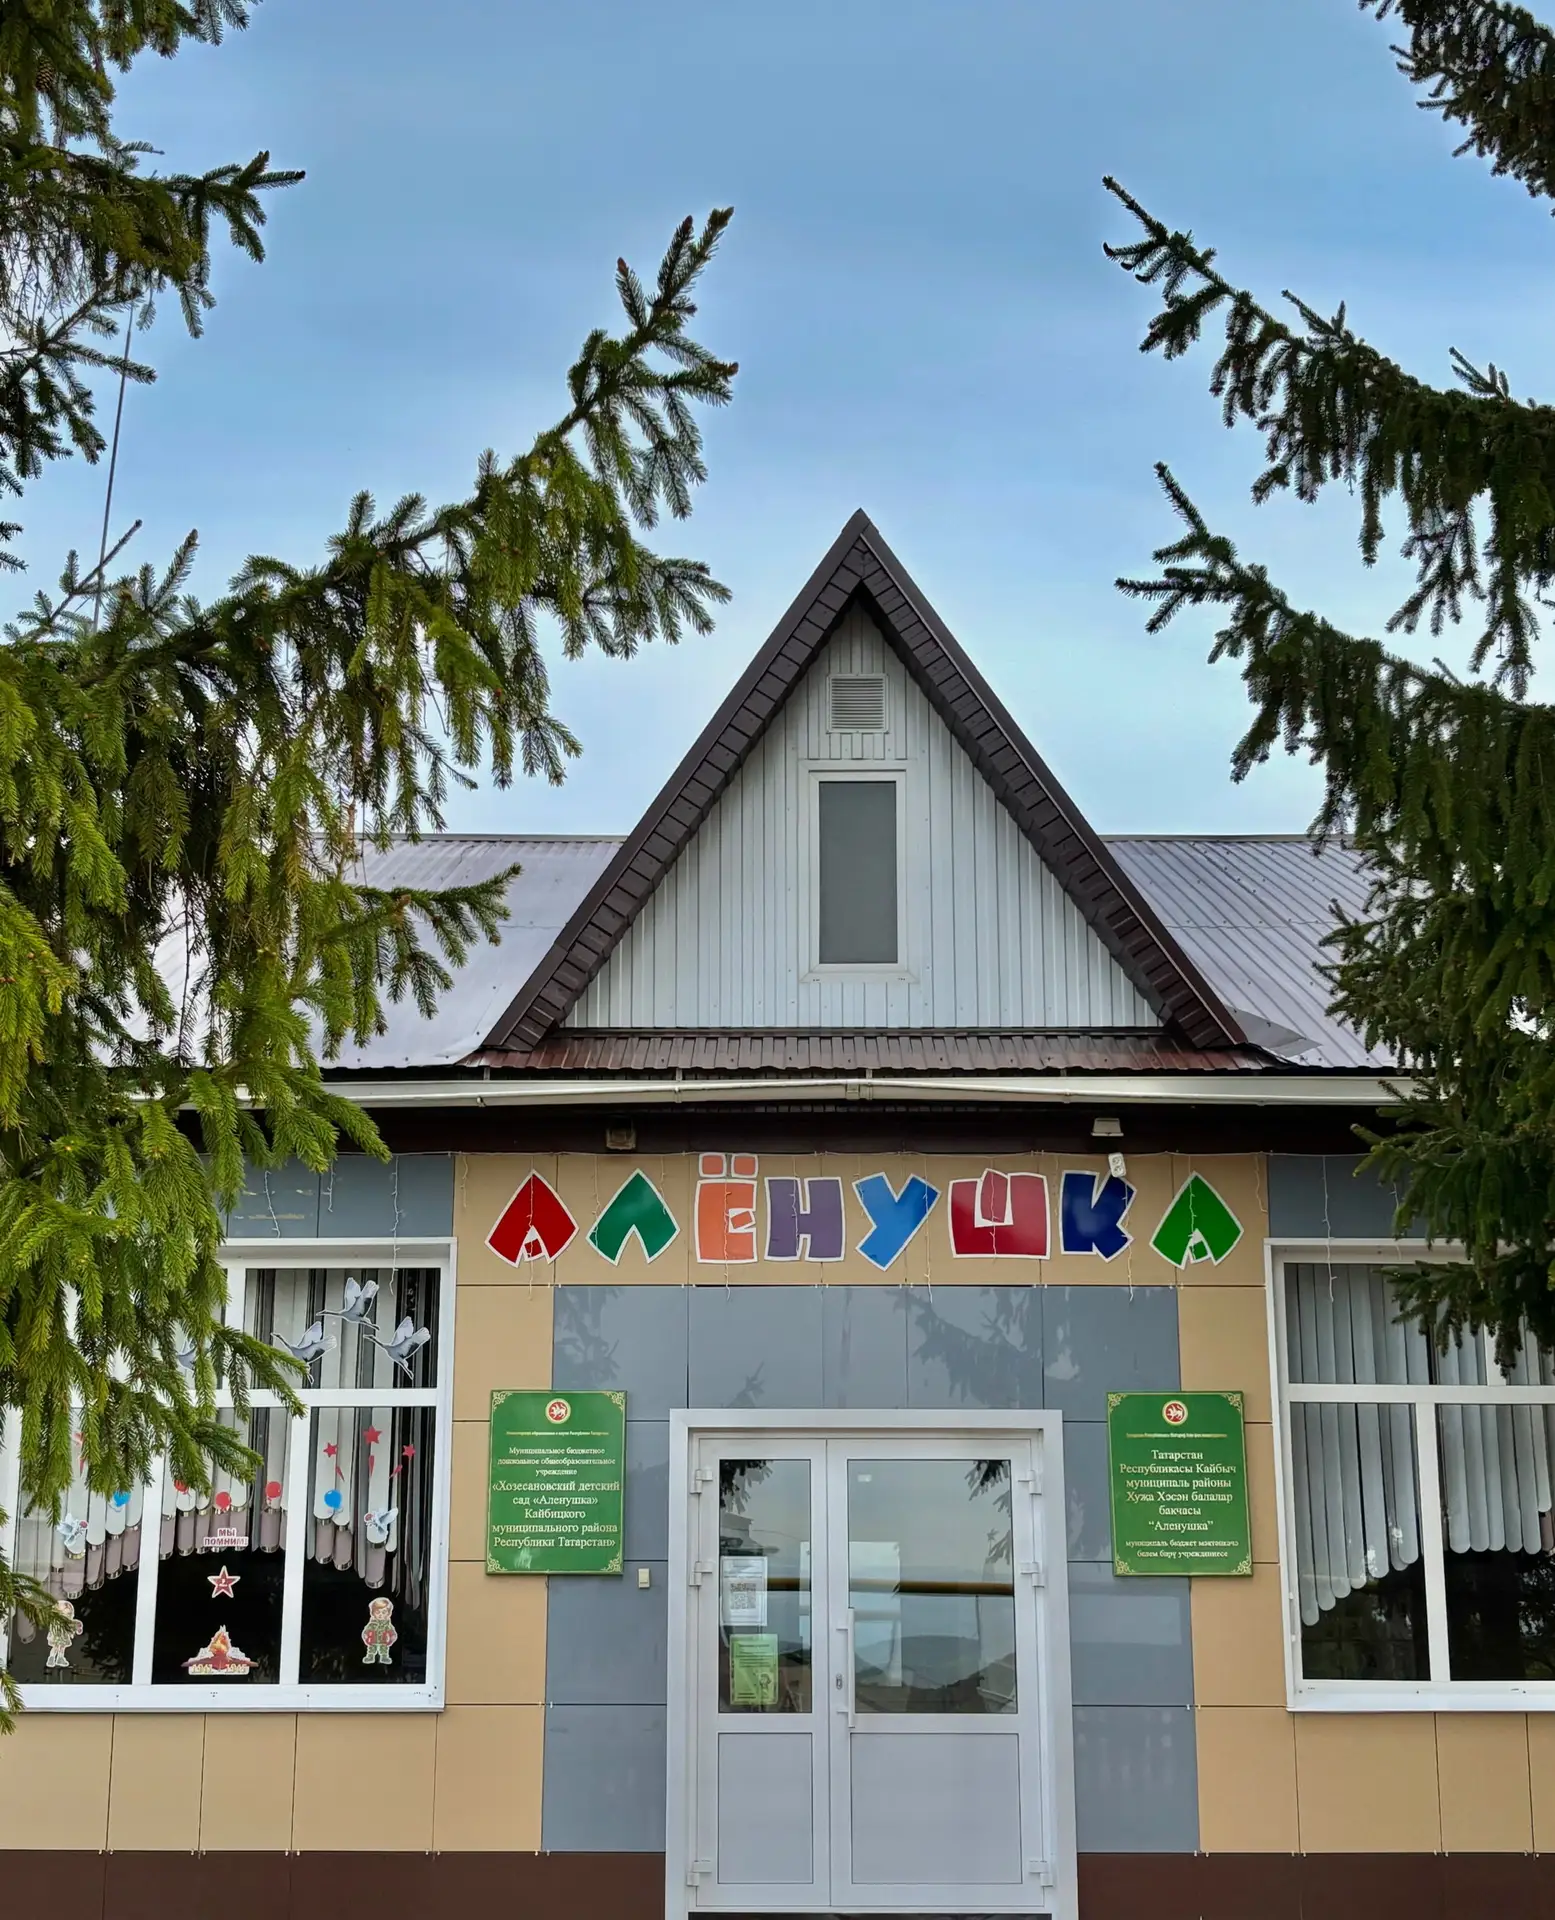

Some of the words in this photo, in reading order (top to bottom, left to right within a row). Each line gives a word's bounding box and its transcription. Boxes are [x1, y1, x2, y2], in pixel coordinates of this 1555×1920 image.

[483, 1151, 1245, 1270] АЛЁНУШКА
[1151, 1449, 1204, 1462] Татарстан
[1119, 1463, 1193, 1475] Республикасы
[1195, 1463, 1237, 1474] Кайбыч
[492, 1480, 576, 1491] «Хозесановский
[578, 1481, 620, 1492] детский
[1125, 1478, 1190, 1489] муниципаль
[1192, 1477, 1232, 1489] районы
[512, 1496, 531, 1506] сад
[1126, 1491, 1155, 1502] Хужа
[1191, 1490, 1233, 1504] балалар
[524, 1507, 586, 1520] Кайбицкого
[1158, 1504, 1202, 1516] бакчасы
[218, 1528, 236, 1537] МЫ
[492, 1524, 579, 1534] муниципального
[581, 1522, 618, 1535] района
[494, 1537, 555, 1548] Республики
[557, 1536, 616, 1548] Татарстан»
